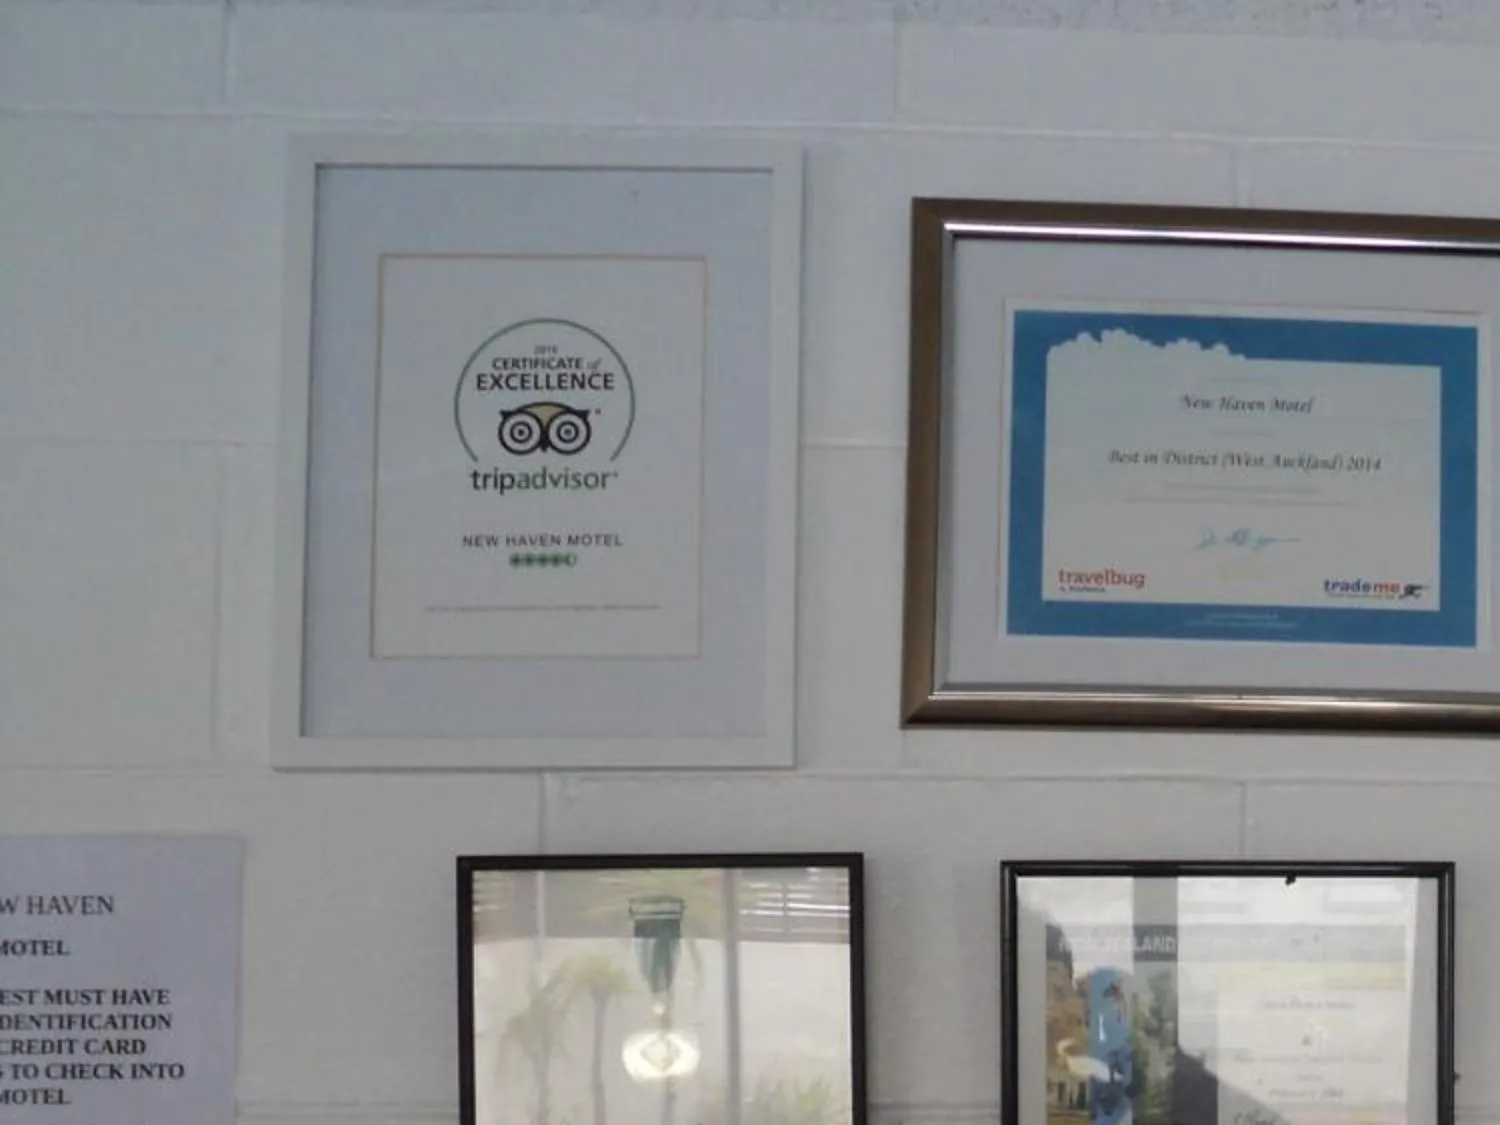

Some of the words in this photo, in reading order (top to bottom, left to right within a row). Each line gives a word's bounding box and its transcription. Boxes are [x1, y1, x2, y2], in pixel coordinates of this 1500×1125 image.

[491, 356, 582, 371] CERTIFICATE
[475, 372, 615, 392] EXCELLENCE
[1178, 394, 1212, 411] New
[1218, 396, 1268, 413] Haven
[1271, 397, 1315, 414] Motel
[1107, 449, 1141, 466] Best
[1143, 451, 1159, 466] in
[1163, 449, 1219, 467] District
[1221, 452, 1266, 471] (West
[1271, 453, 1344, 474] Auckland)
[470, 467, 611, 494] tripadvisor
[462, 535, 500, 548] NEW
[505, 534, 562, 548] HAVEN
[567, 534, 624, 547] MOTEL
[1058, 568, 1146, 589] travelbug
[26, 895, 114, 915] HAVEN
[44, 989, 106, 1005] MUST
[112, 989, 171, 1005] HAVE
[84, 1038, 146, 1055] CARD
[12, 1063, 39, 1080] TO
[45, 1063, 124, 1080] CHECK
[131, 1063, 185, 1080] INTO
